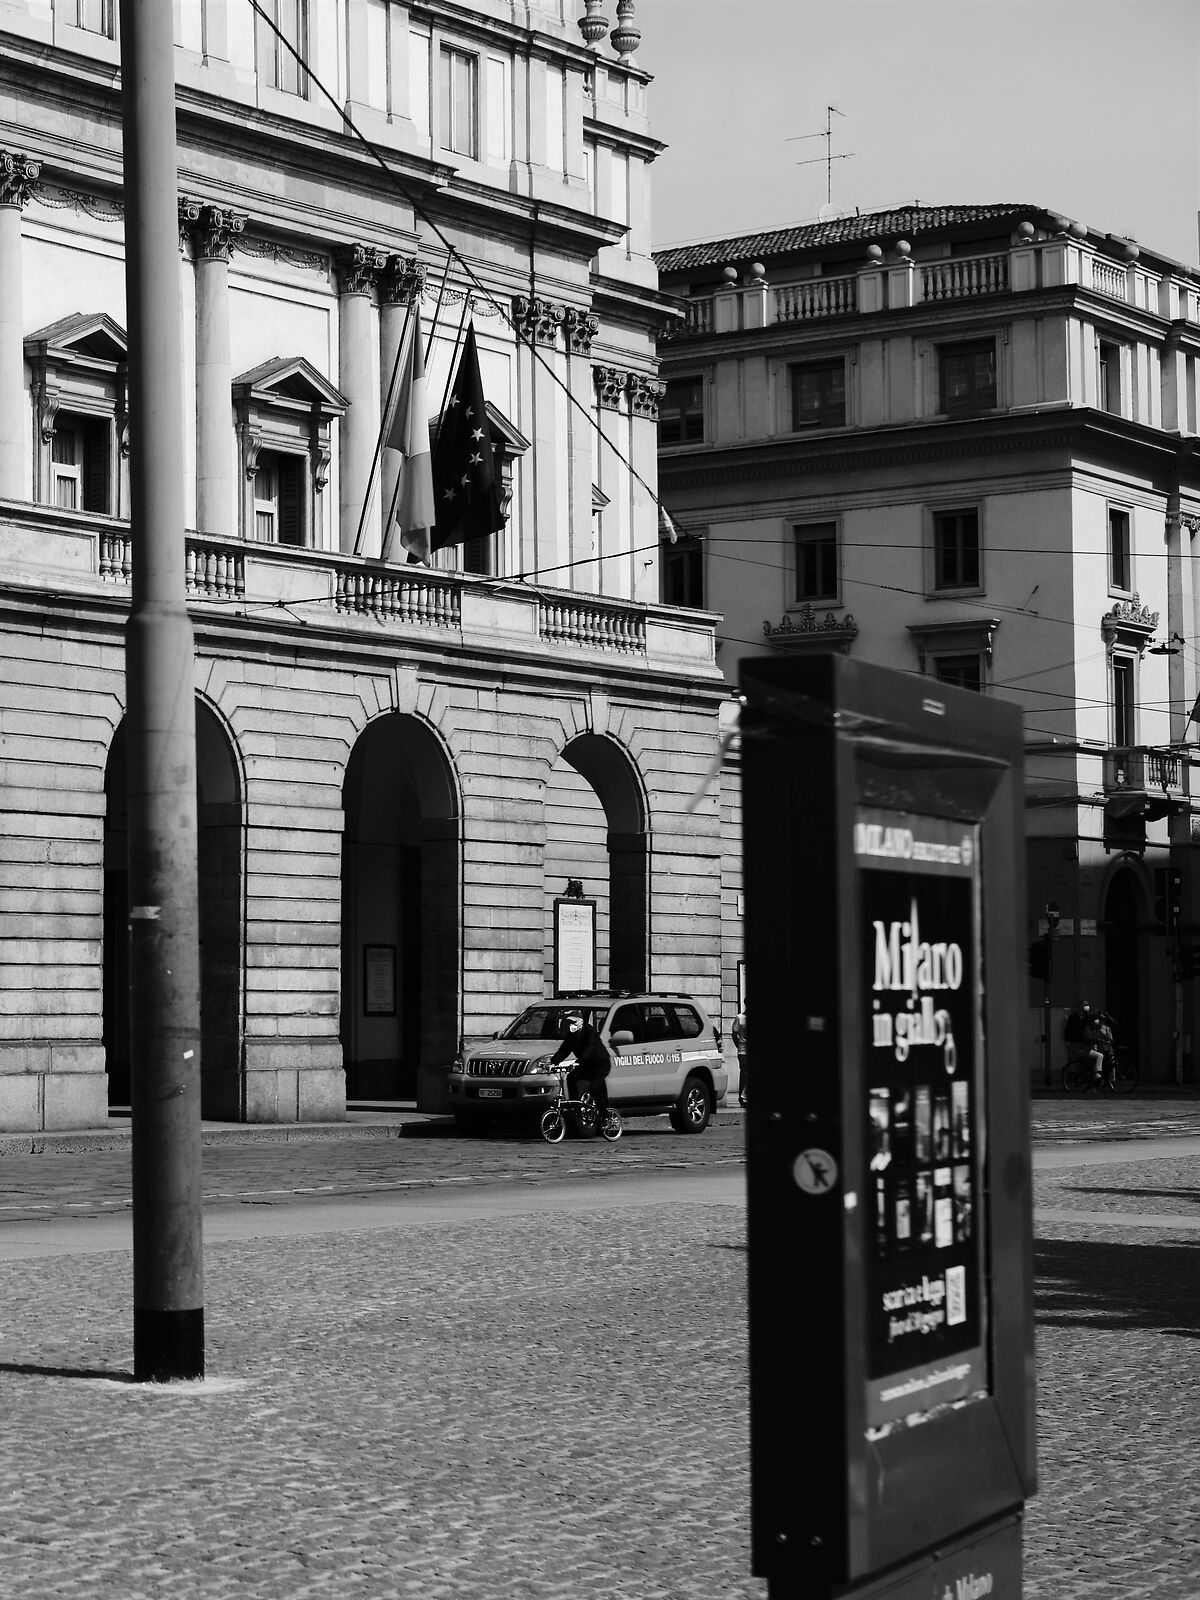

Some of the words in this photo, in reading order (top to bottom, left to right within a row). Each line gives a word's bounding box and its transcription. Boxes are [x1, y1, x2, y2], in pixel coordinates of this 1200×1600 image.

[873, 998, 893, 1048] in
[613, 1055, 633, 1067] VIGILI
[632, 1054, 645, 1066] DEL
[645, 1053, 665, 1065] FUOCO
[671, 1053, 680, 1063] 115
